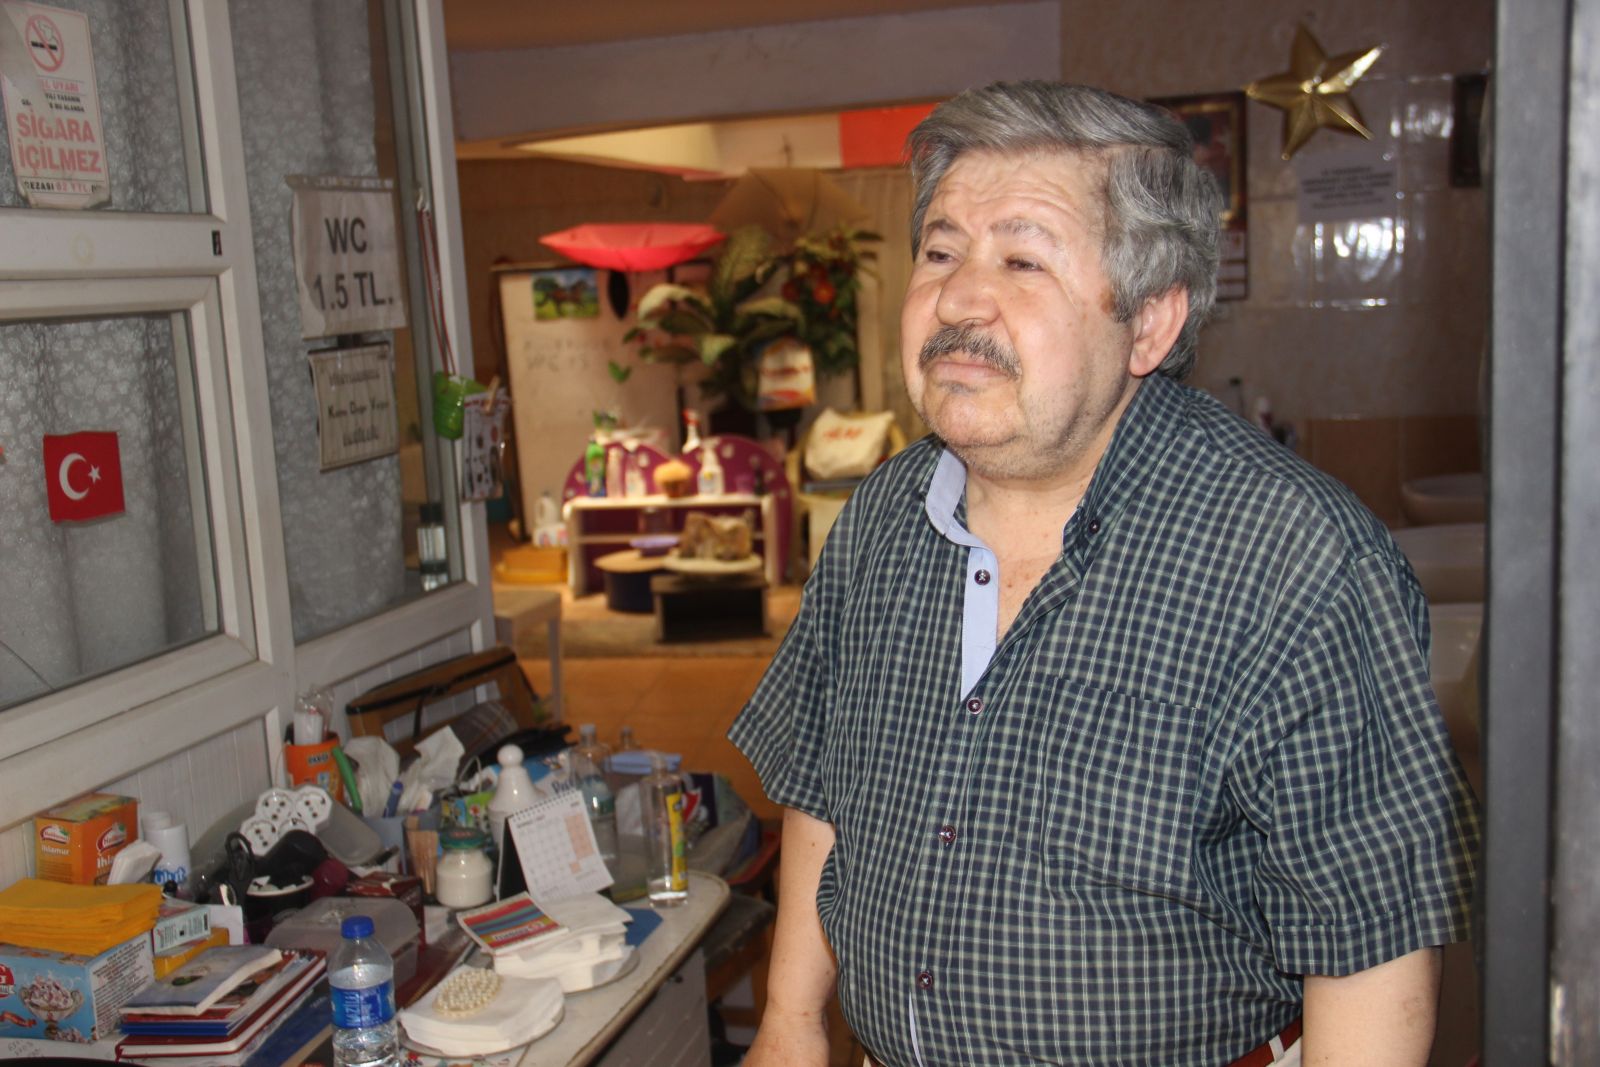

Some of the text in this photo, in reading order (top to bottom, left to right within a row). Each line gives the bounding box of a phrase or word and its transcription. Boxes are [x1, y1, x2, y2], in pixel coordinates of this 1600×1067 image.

[16, 109, 96, 143] SİGARA
[17, 138, 102, 176] İÇİLMEZ
[325, 217, 367, 254] WC
[314, 271, 394, 310] 1.5 TL.
